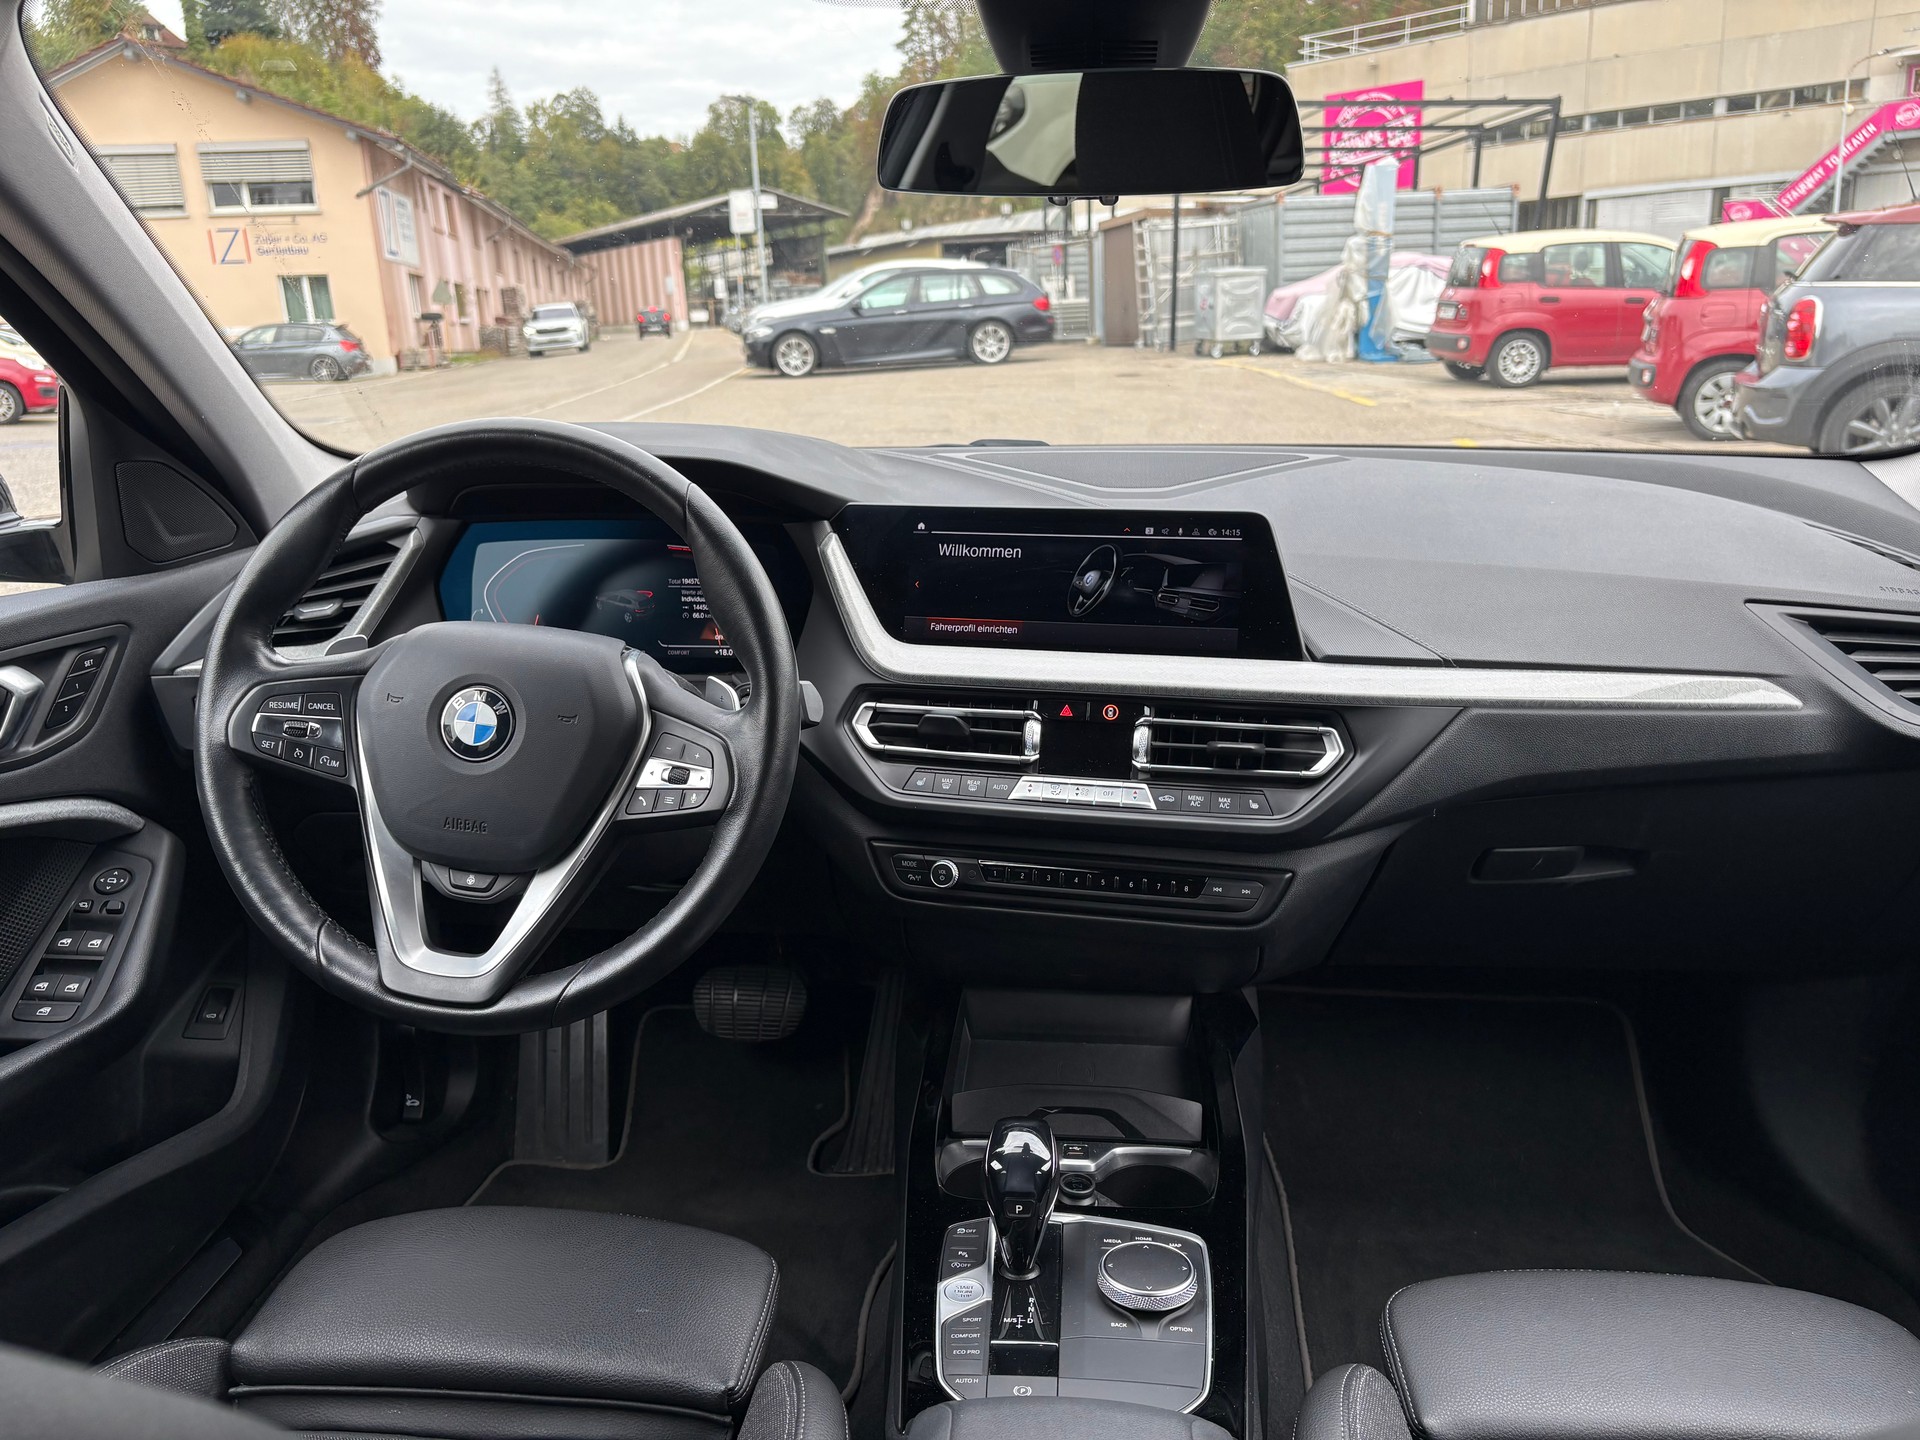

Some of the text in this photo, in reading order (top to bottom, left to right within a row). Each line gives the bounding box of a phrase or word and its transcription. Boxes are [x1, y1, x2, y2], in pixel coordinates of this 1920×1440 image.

[1824, 153, 1840, 169] TO
[1840, 122, 1878, 160] HEAVEN
[1221, 528, 1241, 537] 14:15
[938, 543, 1022, 558] Willkommen
[930, 622, 1018, 635] Fahrerprofil einrichten
[714, 648, 733, 656] +18.0
[84, 659, 94, 667] SET
[269, 701, 299, 709] RESUME
[308, 702, 335, 710] CANCEL
[452, 690, 508, 716] BMW
[261, 740, 276, 749] SET
[326, 759, 340, 768] LIM
[443, 816, 488, 834] AIRBAG
[901, 860, 918, 868] MODE
[1015, 1204, 1023, 1214] P
[1169, 1325, 1193, 1333] OPTION
